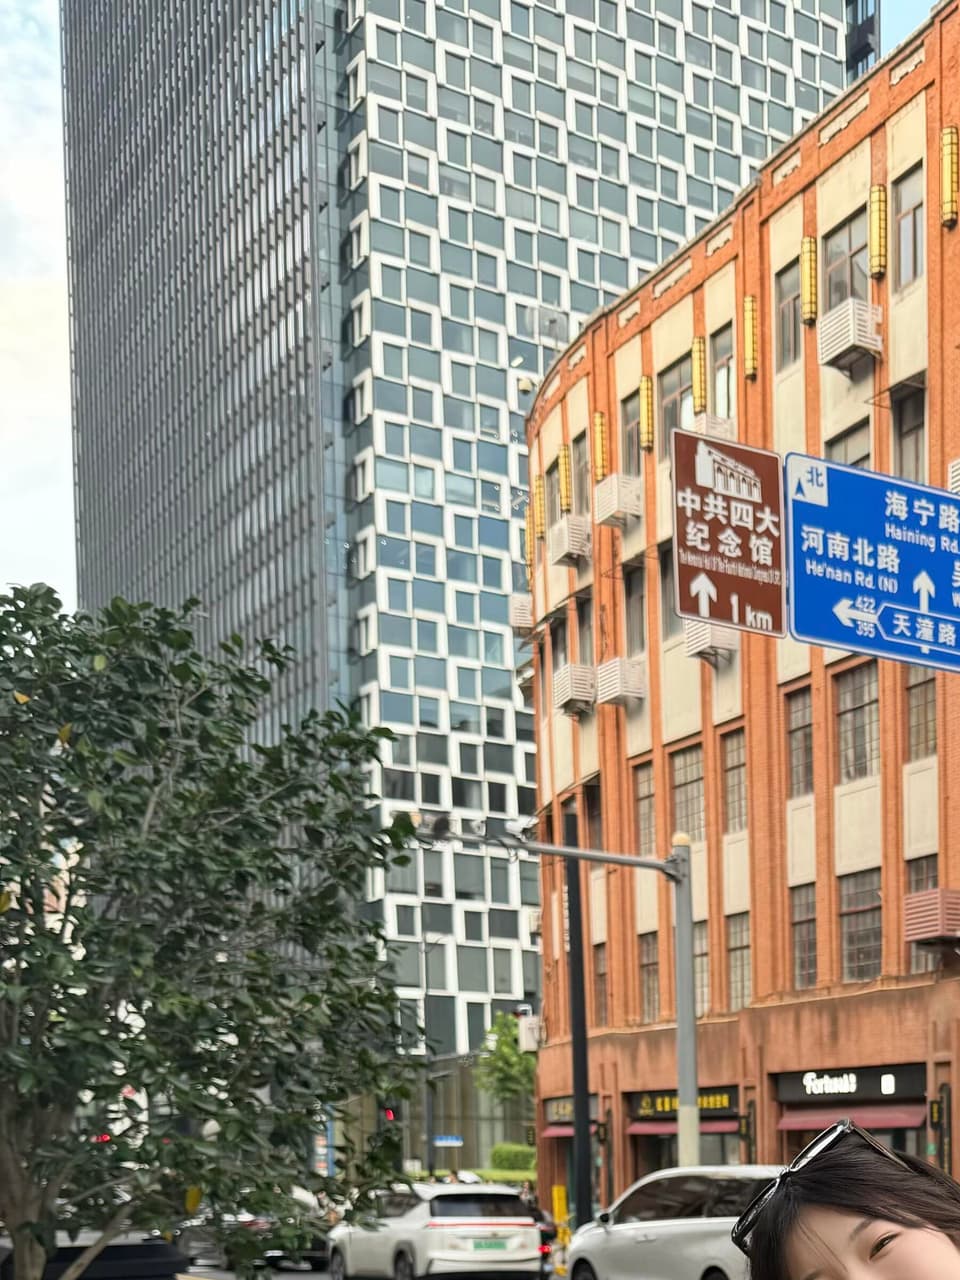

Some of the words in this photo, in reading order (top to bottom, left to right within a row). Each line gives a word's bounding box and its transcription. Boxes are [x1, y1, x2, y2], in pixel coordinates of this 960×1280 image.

[807, 467, 824, 488] 北
[677, 488, 780, 537] 中共四大
[885, 490, 960, 534] 海宁路
[686, 523, 773, 566] 纪念馆
[801, 525, 900, 574] 河南北路
[885, 524, 935, 552] Haining
[941, 534, 960, 554] Rd.
[806, 560, 851, 585] He'nan
[855, 570, 876, 589] Rd.
[878, 574, 899, 594] (N)
[730, 594, 739, 624] 1
[745, 603, 772, 631] km
[893, 613, 957, 646] 天潼路
